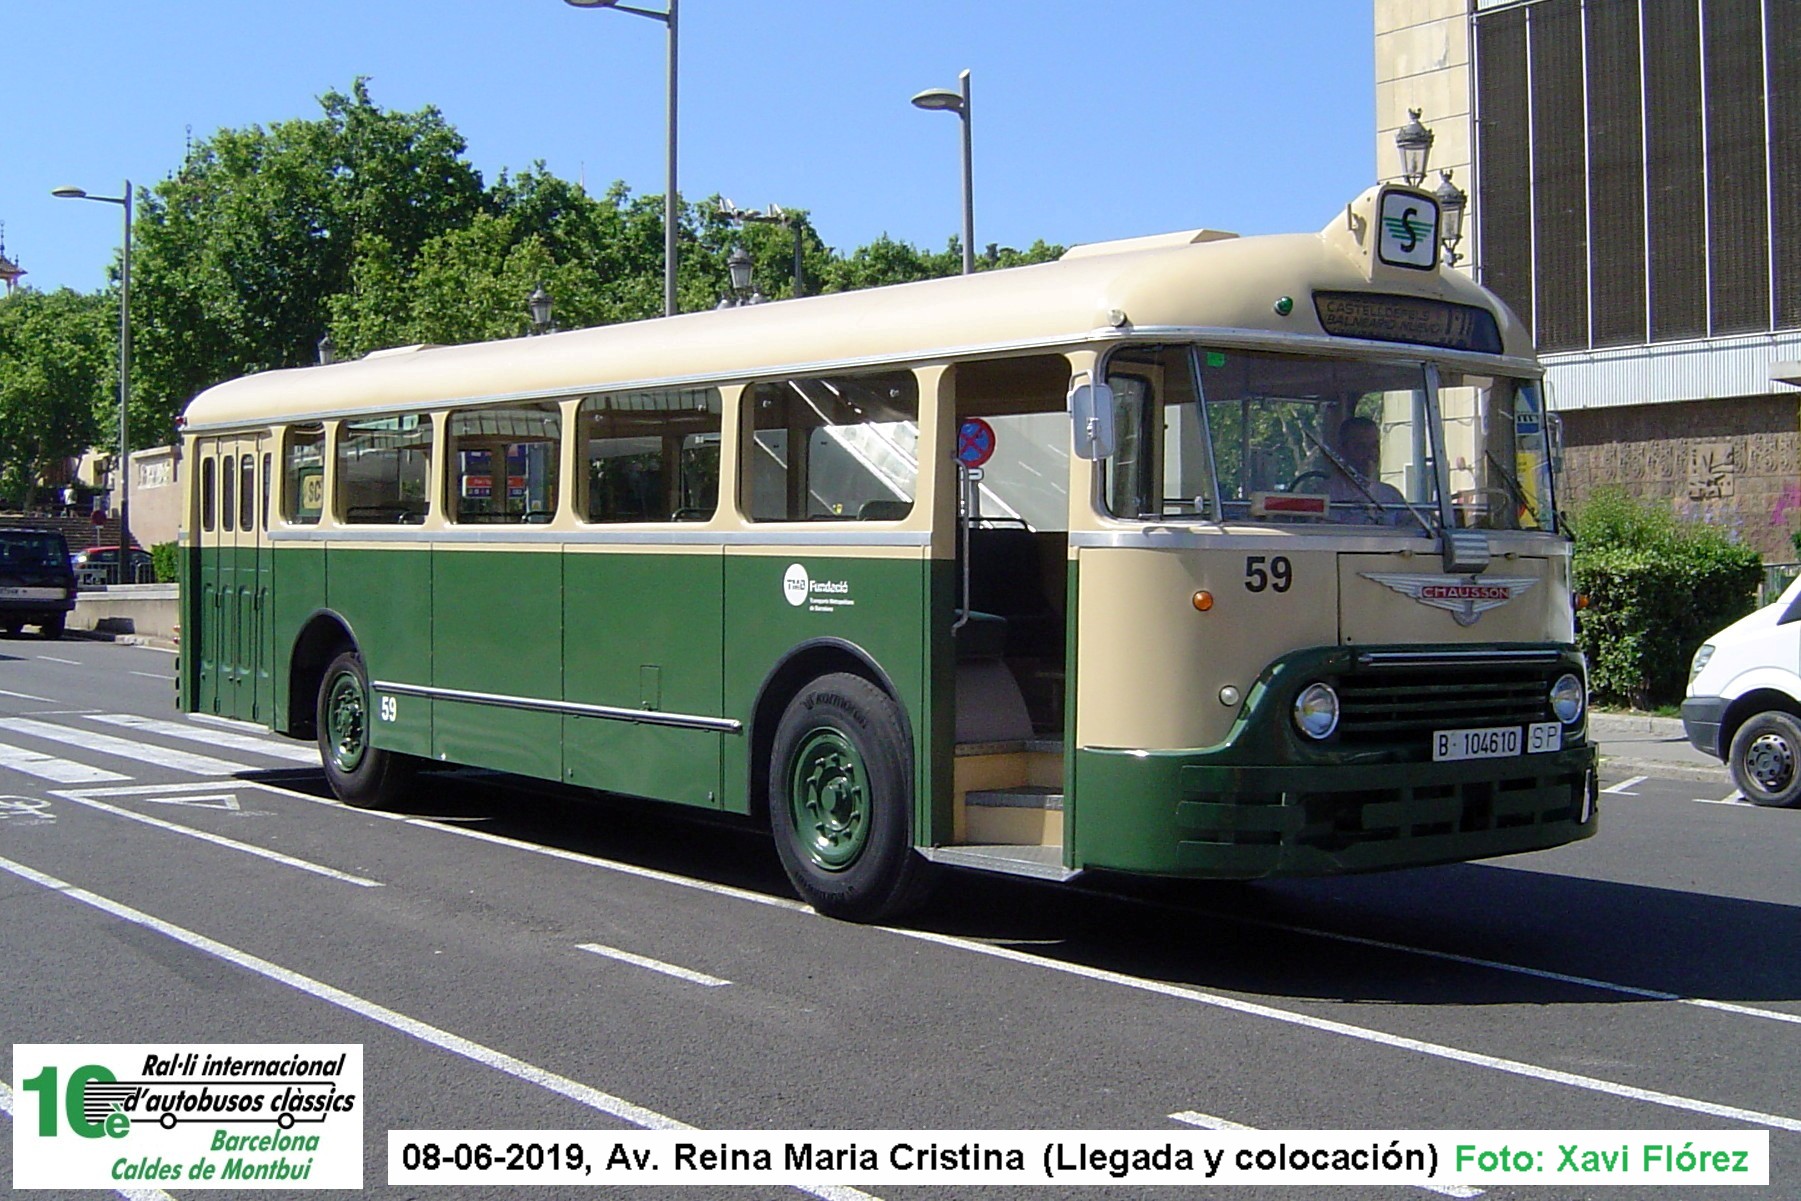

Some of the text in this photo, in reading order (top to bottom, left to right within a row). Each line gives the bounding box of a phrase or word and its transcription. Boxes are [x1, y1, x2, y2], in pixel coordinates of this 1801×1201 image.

[1244, 555, 1293, 593] 59
[809, 580, 849, 594] Fundació
[1422, 586, 1510, 600] CHAUSSON
[381, 695, 397, 722] 59
[1532, 726, 1558, 749] SP
